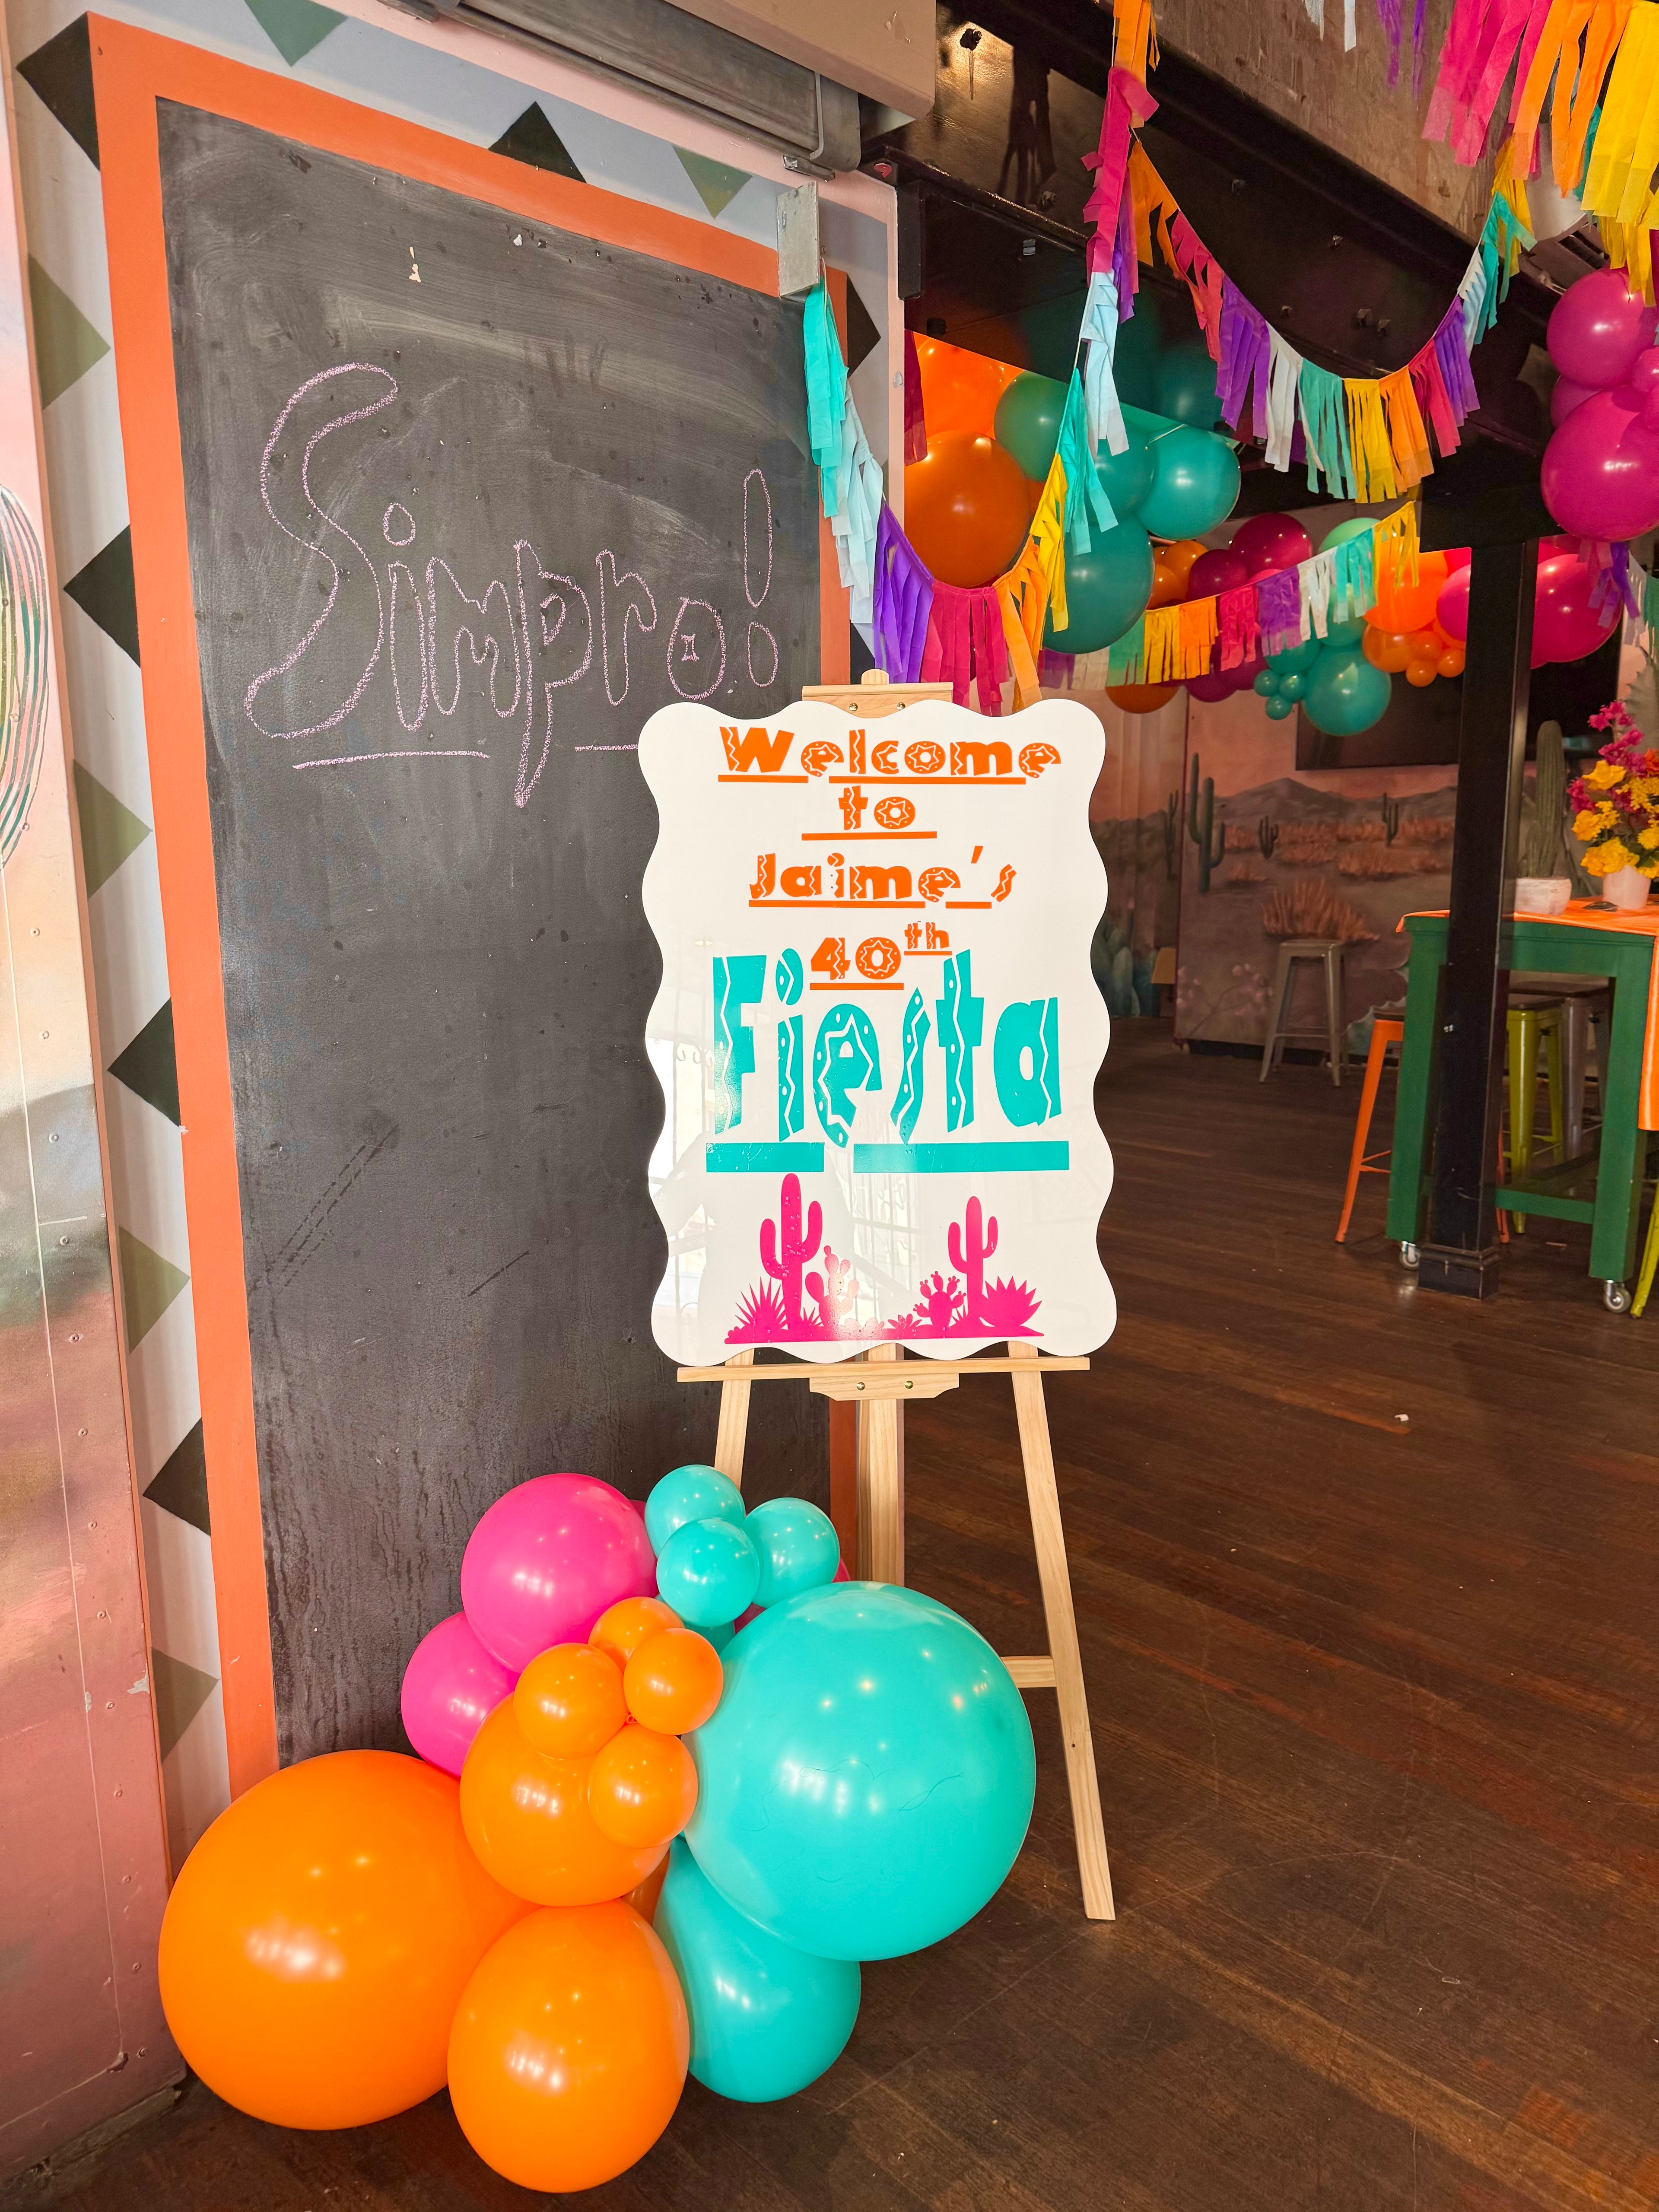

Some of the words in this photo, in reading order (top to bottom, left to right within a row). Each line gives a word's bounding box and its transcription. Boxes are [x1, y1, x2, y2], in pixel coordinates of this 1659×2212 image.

[720, 727, 1061, 778] Welcome
[839, 786, 915, 830] to
[750, 846, 1016, 900] Jaime's
[811, 922, 949, 980] 40th
[712, 949, 1062, 1148] Fiesta
